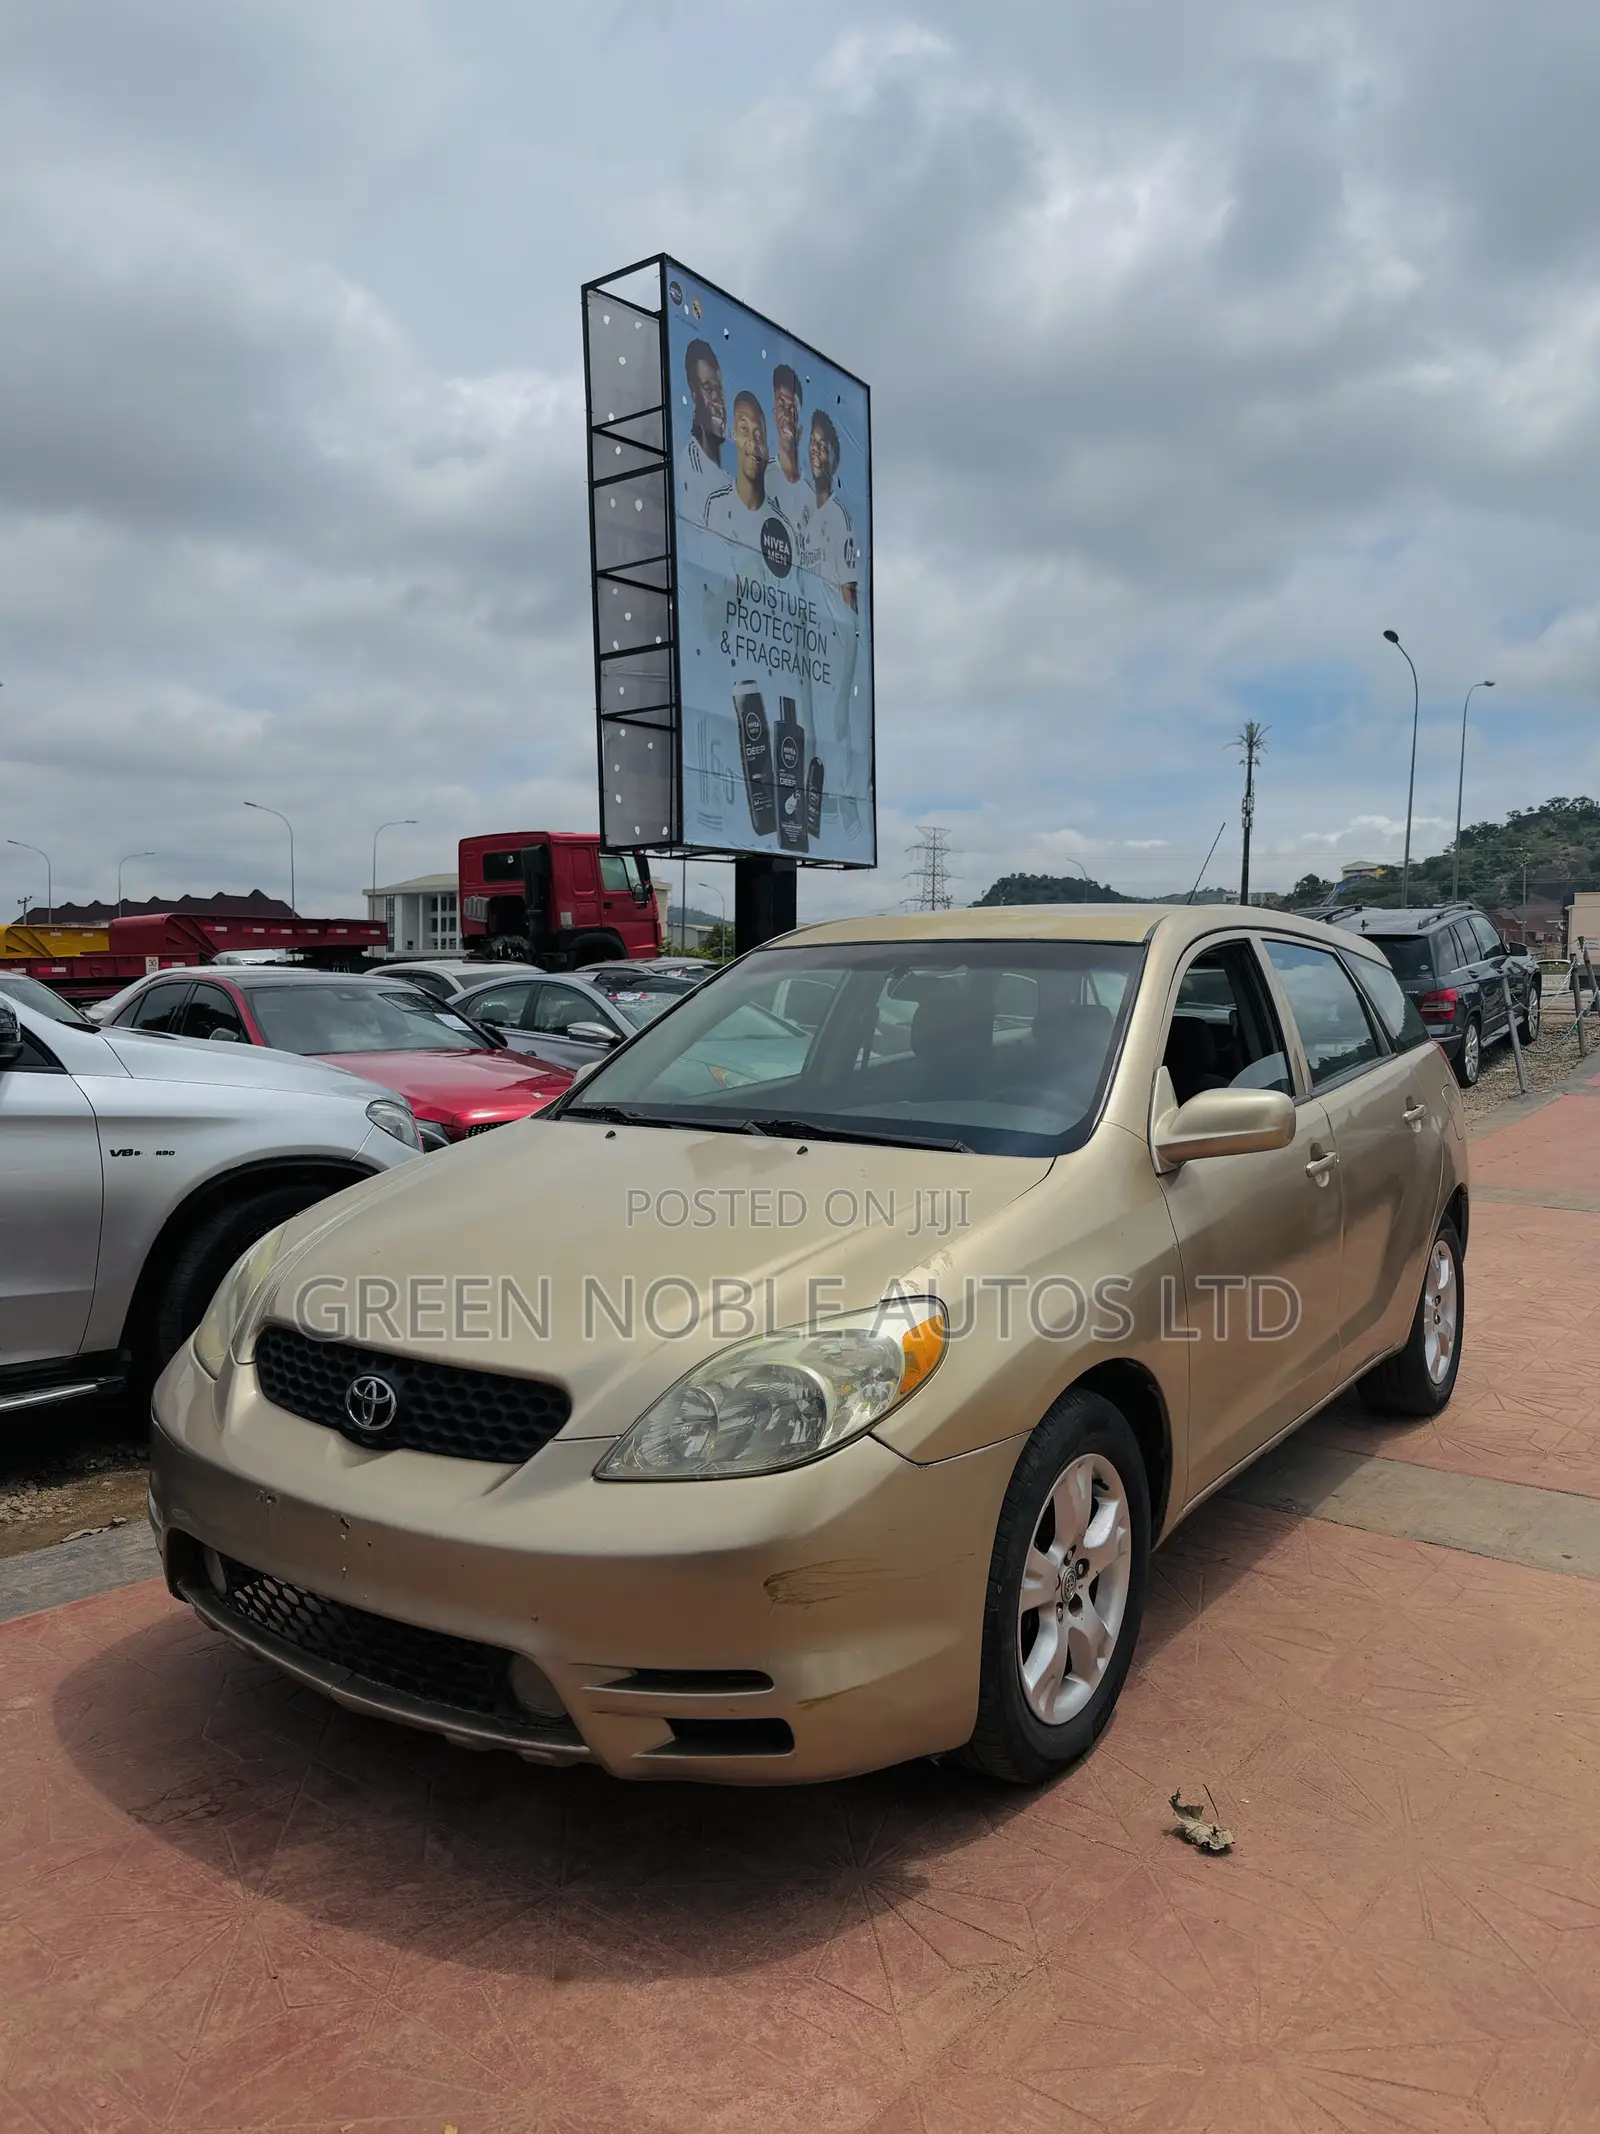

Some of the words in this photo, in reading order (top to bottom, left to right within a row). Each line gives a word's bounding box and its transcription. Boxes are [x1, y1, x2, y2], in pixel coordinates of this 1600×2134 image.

[764, 534, 790, 555] NIVEA
[767, 550, 787, 566] MEN
[726, 601, 827, 657] PROTECTION
[720, 630, 731, 655] &
[736, 635, 831, 685] FRAGRANCE
[746, 745, 766, 756] DEEP
[779, 777, 797, 787] DEEP
[148, 959, 157, 967] 30
[109, 1149, 134, 1157] V8
